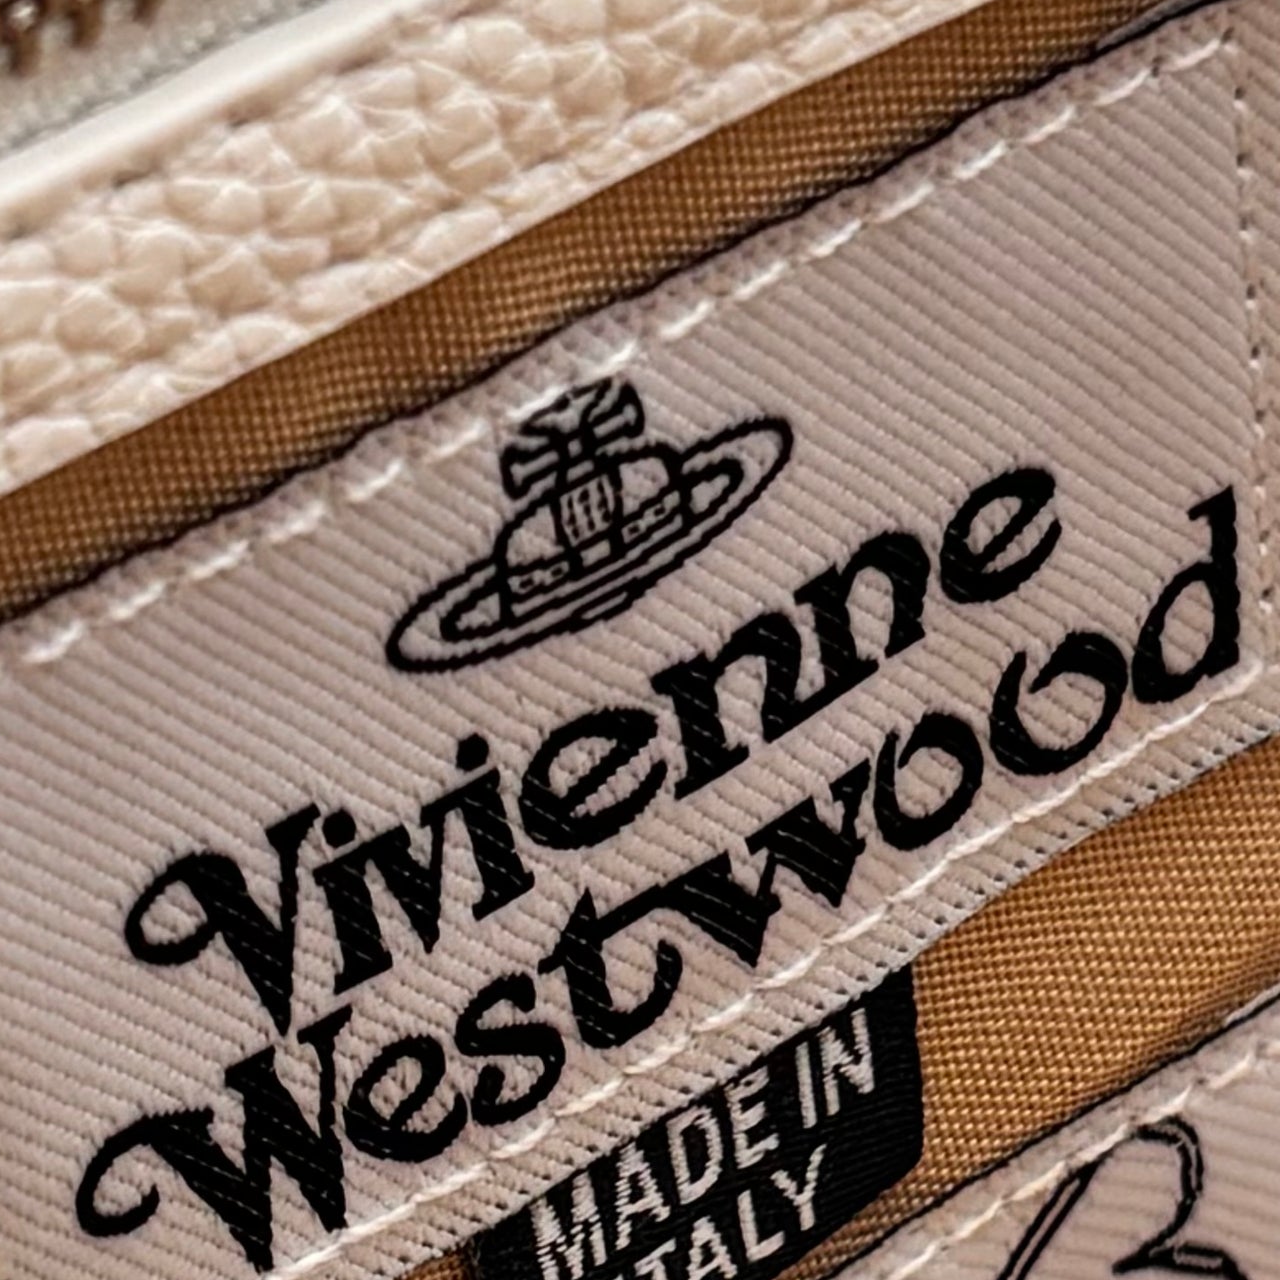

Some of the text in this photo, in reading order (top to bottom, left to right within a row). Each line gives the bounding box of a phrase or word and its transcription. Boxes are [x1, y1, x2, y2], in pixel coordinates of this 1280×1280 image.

[75, 484, 1242, 1272] Westwood
[125, 466, 1062, 1034] Vivienne
[796, 1006, 876, 1131] IN
